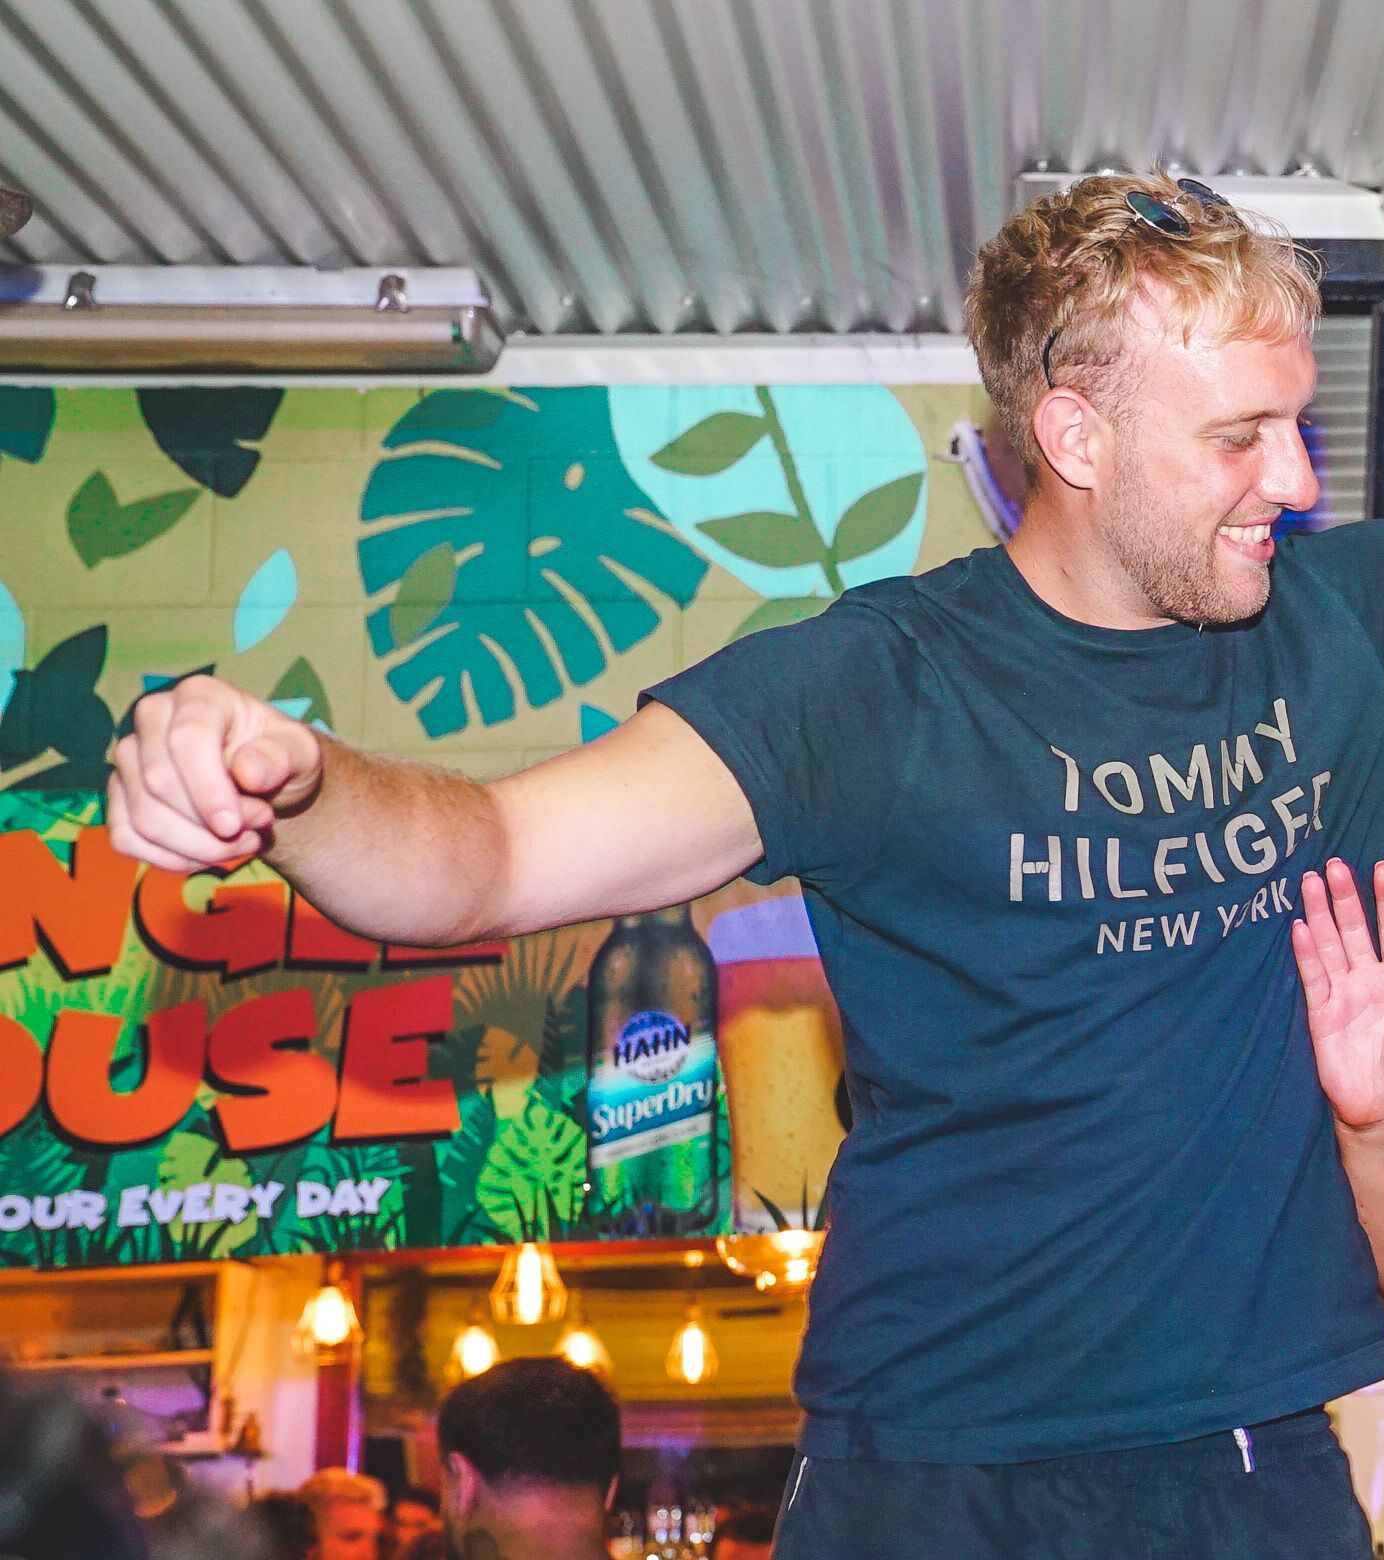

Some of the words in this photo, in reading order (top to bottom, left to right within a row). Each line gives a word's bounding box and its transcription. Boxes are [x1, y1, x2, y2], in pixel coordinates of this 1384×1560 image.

[1050, 697, 1298, 815] TOMMY
[1096, 910, 1200, 955] NEW
[613, 1022, 692, 1068] HAHN
[592, 1079, 713, 1140] SuperDry
[296, 1178, 391, 1218] DAY
